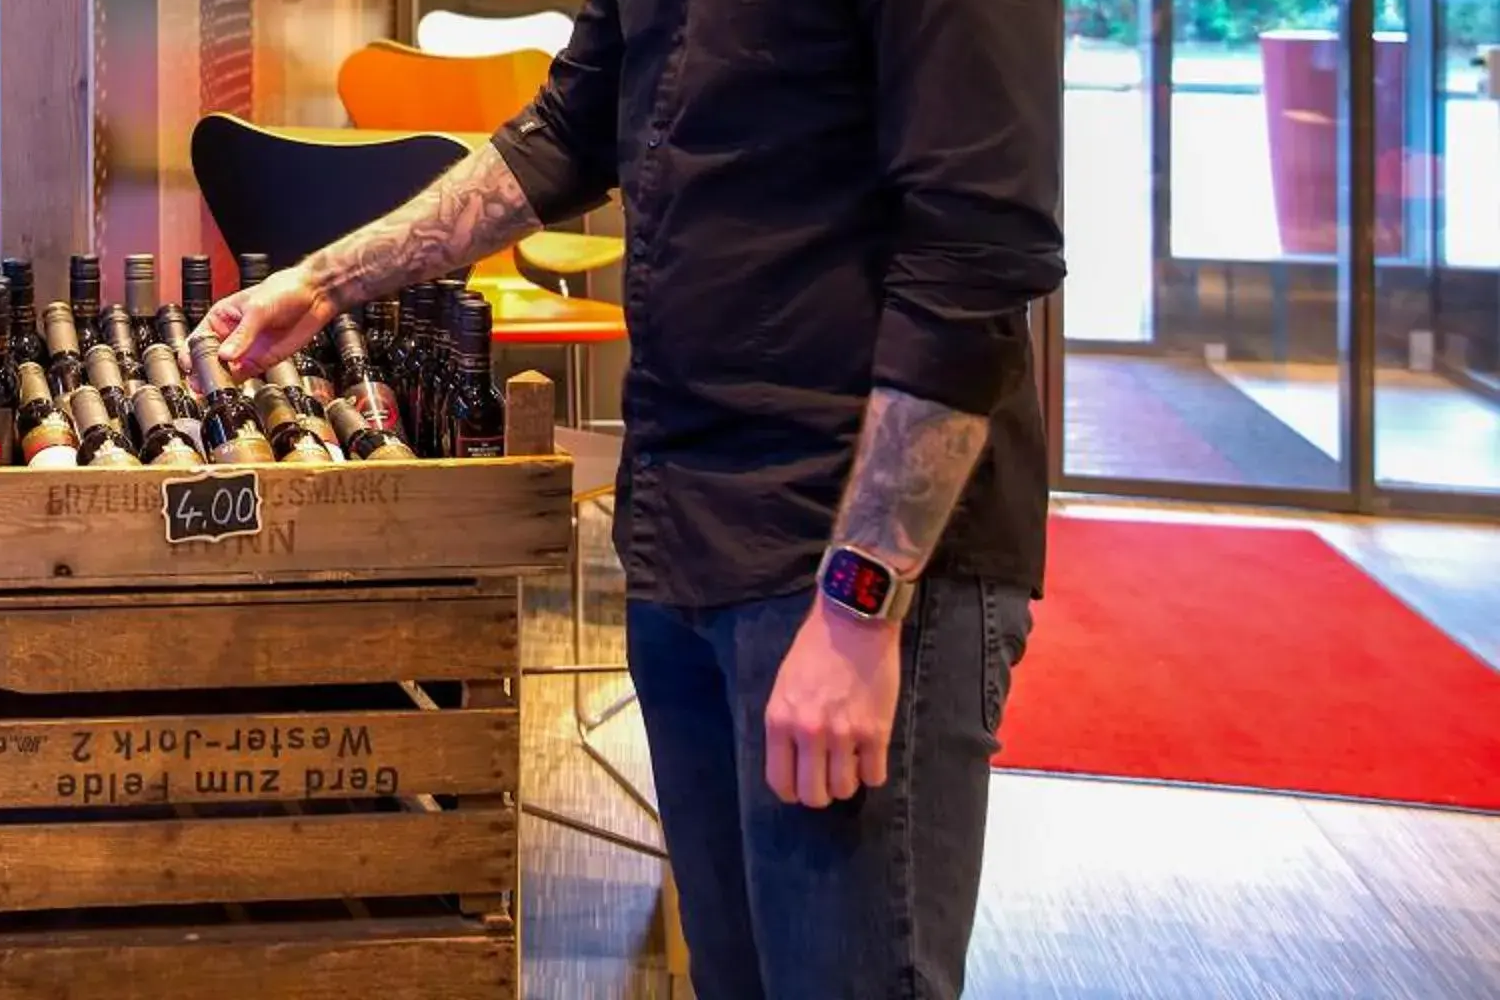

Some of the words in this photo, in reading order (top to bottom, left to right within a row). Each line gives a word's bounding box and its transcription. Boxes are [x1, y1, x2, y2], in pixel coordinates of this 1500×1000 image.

[175, 486, 256, 531] 4.00
[71, 731, 92, 763] 2
[112, 726, 374, 761] Wester-Jork
[57, 770, 169, 803] Felde
[195, 769, 280, 795] zum
[303, 766, 399, 798] Gerd
